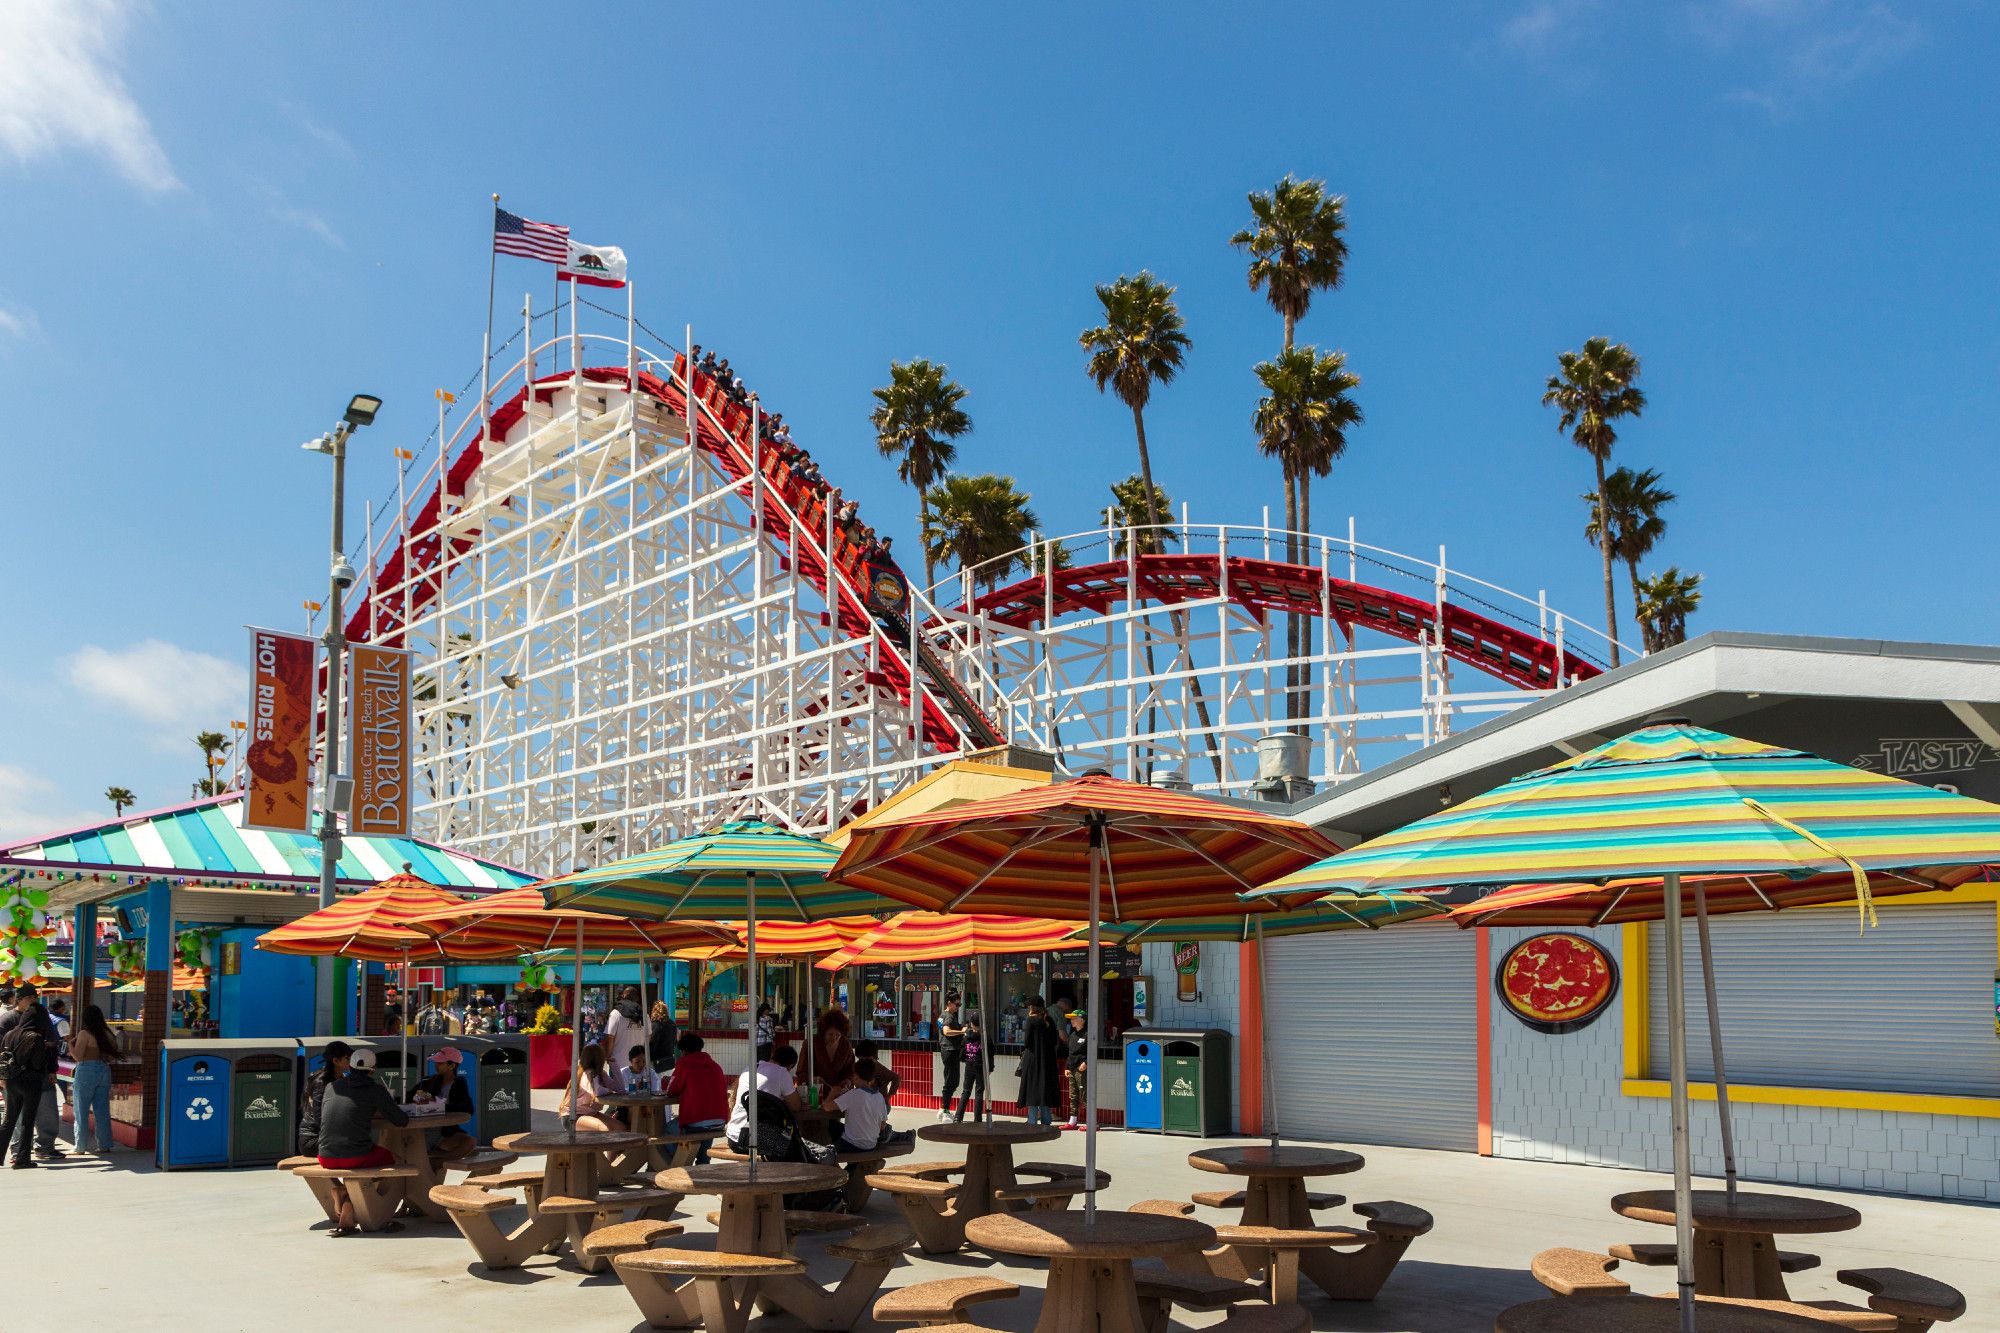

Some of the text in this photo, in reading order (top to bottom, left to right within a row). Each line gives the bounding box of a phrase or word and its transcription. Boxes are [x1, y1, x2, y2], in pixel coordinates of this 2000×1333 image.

[256, 635, 276, 741] HOT RIDES
[360, 688, 372, 801] Santa Cruz Beach
[361, 654, 401, 831] Boardwalk
[1880, 741, 1982, 775] TASTY
[1176, 945, 1198, 966] BEER
